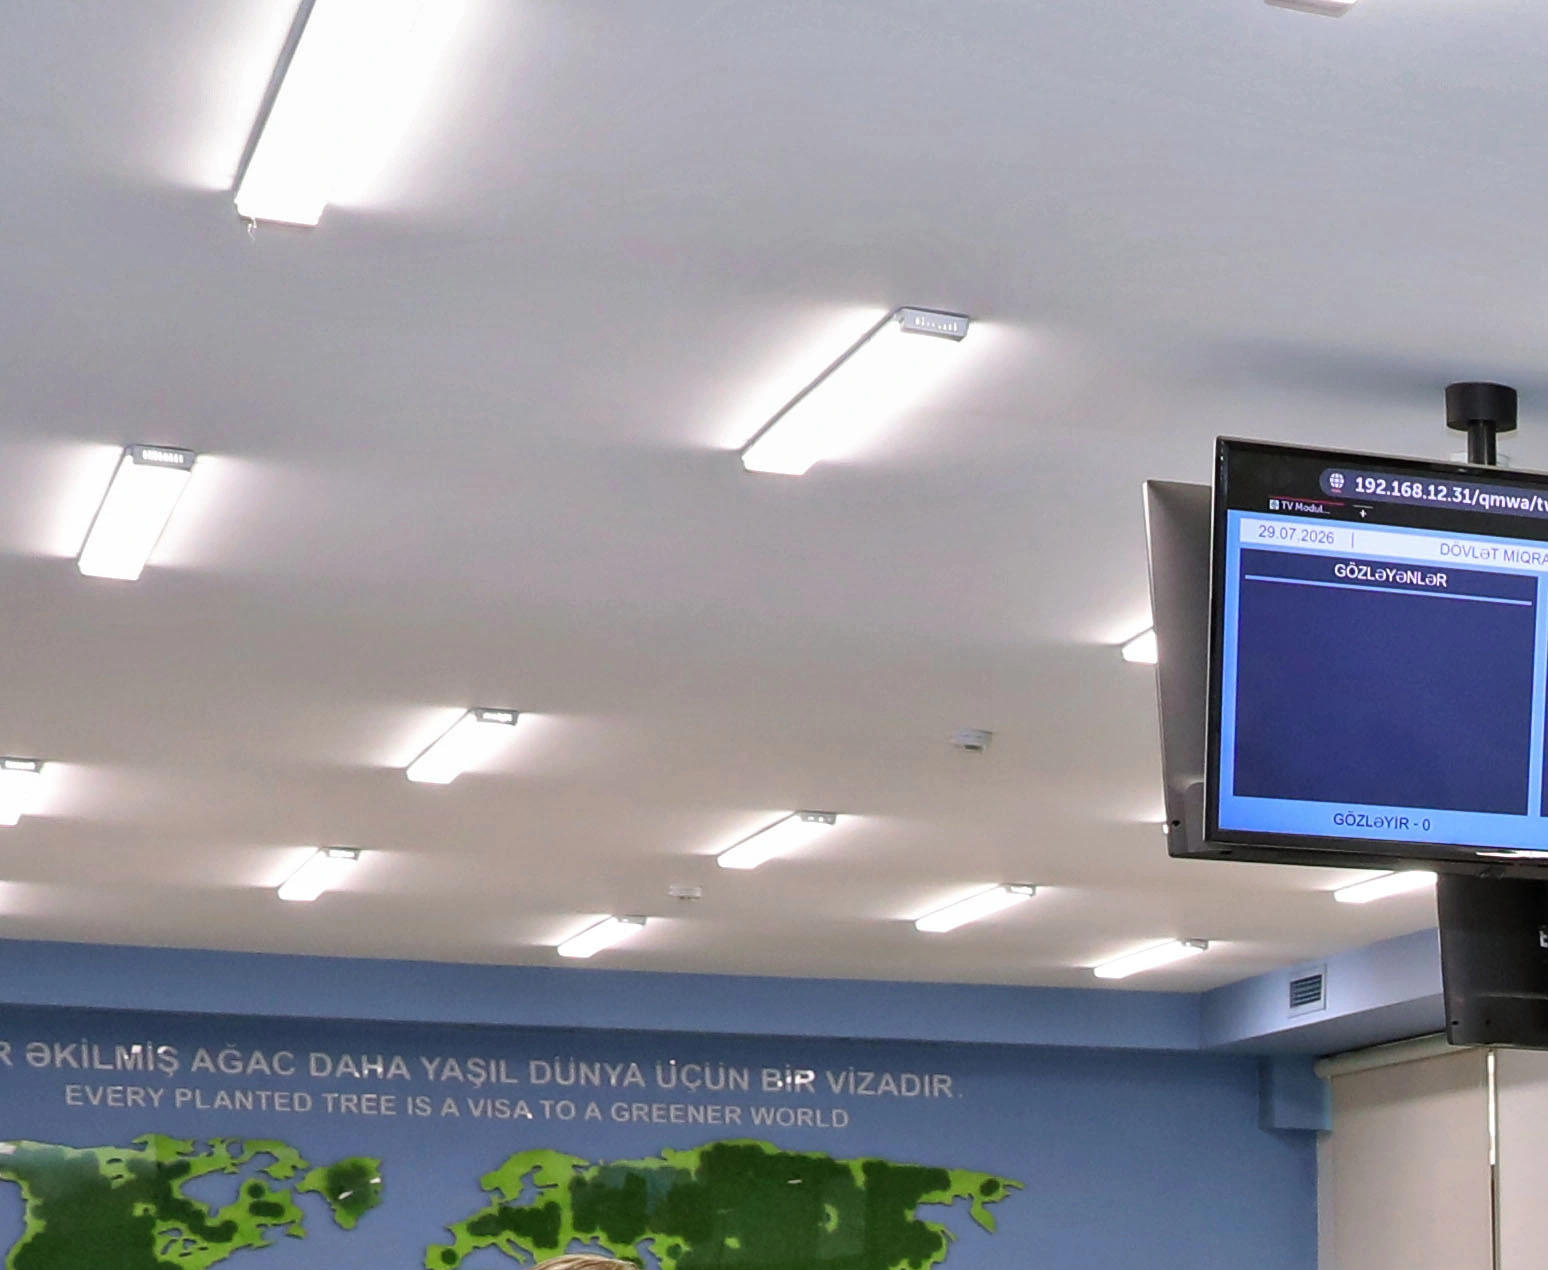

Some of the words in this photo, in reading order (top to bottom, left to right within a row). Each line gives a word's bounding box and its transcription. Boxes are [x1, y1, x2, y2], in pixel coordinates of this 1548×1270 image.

[1281, 501, 1293, 510] TV
[1258, 524, 1335, 545] 29.07.2026
[1422, 818, 1431, 831] 0
[26, 1038, 179, 1077] ƏKİLMİŞ
[191, 1042, 296, 1076] AĞAC
[309, 1052, 411, 1081] DAHA
[419, 1056, 518, 1089] YAŞIL
[529, 1056, 646, 1088] DÜNYA
[656, 1059, 749, 1093] ÜÇÜN
[761, 1063, 816, 1094] BİR
[65, 1083, 164, 1108] EVERY
[175, 1087, 312, 1112] PLANTED
[322, 1093, 396, 1116] TREE
[407, 1096, 432, 1117] IS
[440, 1097, 460, 1117] A
[466, 1098, 533, 1119] VISA
[540, 1100, 576, 1121] TO
[584, 1102, 603, 1121] A
[610, 1101, 742, 1126] GREENER
[750, 1106, 849, 1128] WORLD
